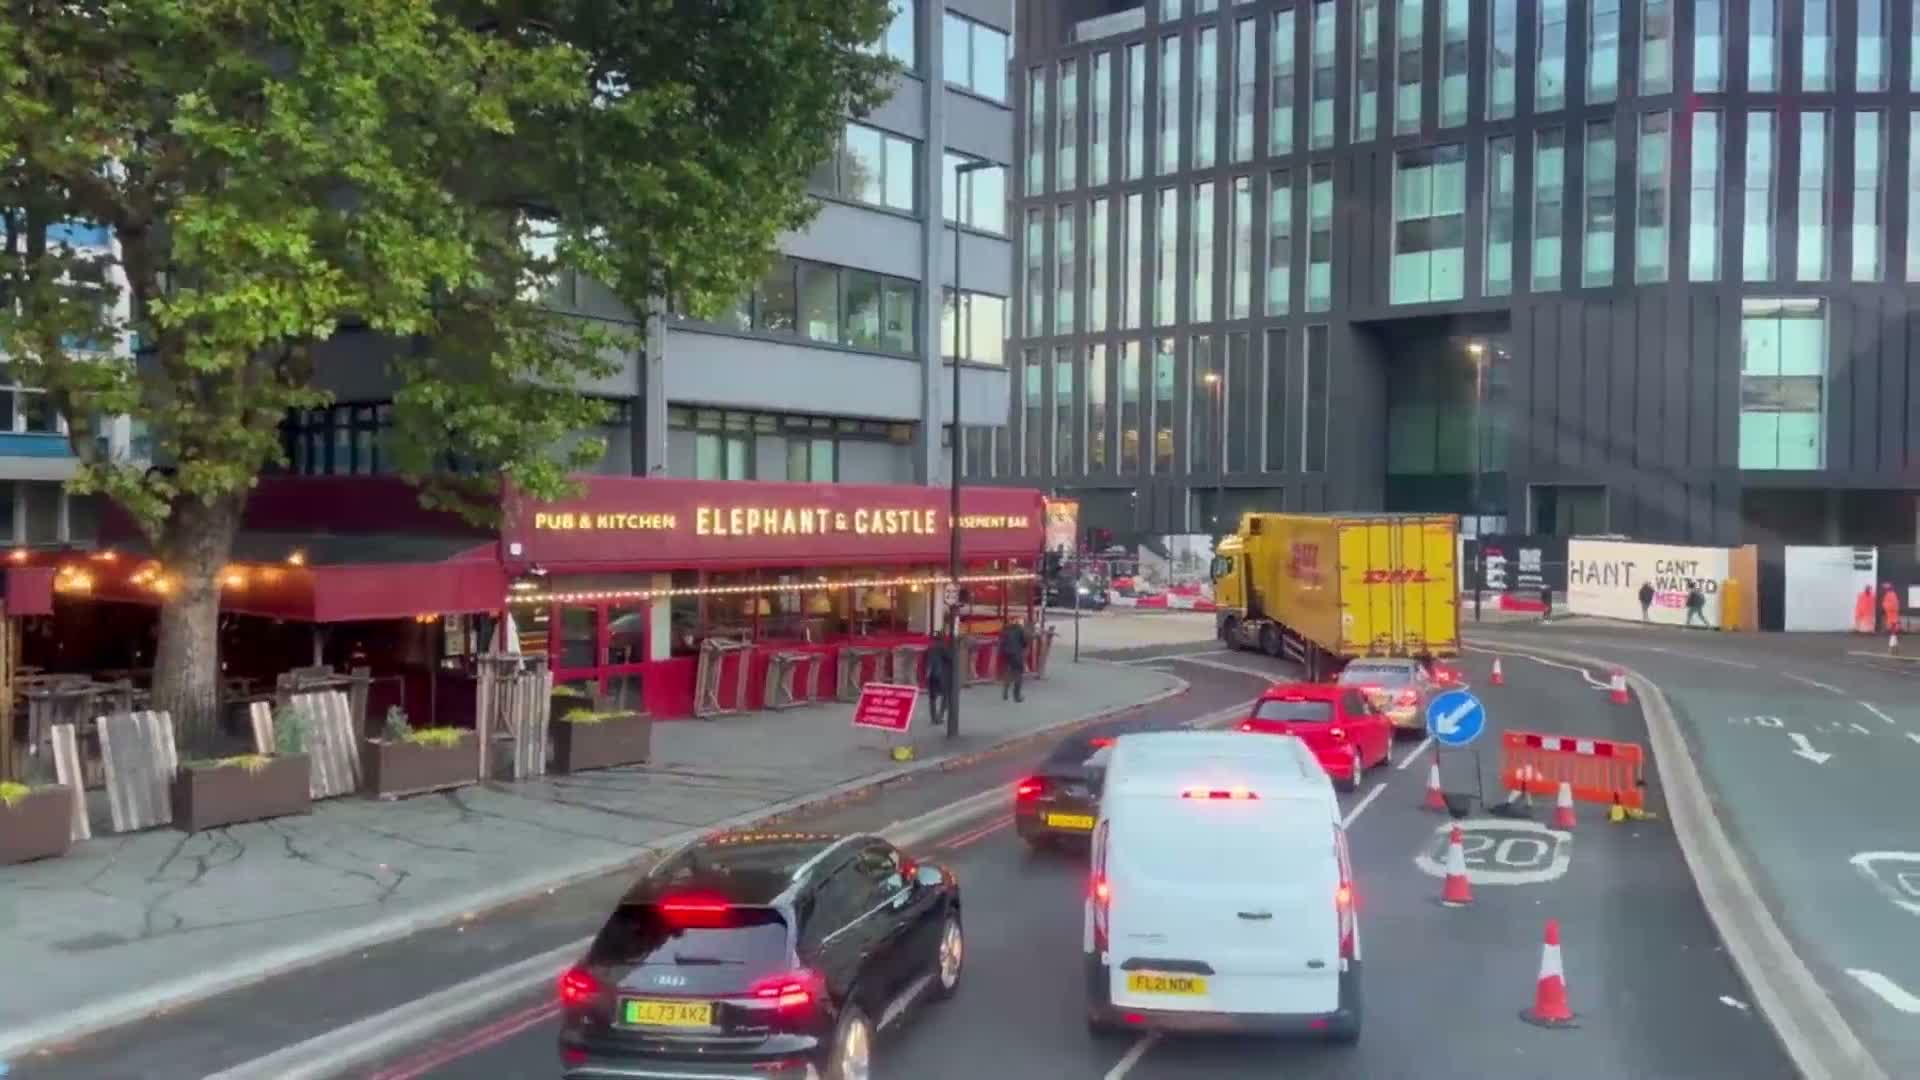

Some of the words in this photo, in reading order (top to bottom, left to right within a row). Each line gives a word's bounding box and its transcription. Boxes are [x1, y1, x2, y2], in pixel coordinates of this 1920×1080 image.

[535, 513, 574, 529] PUB
[579, 514, 592, 529] &
[597, 514, 676, 529] KITCHEN
[696, 507, 831, 535] ELEPHANT
[834, 512, 849, 531] &
[854, 508, 936, 535] CASTLE
[1570, 560, 1636, 587] HANT
[1655, 559, 1699, 576] CAN'T
[1441, 834, 1549, 866] 20
